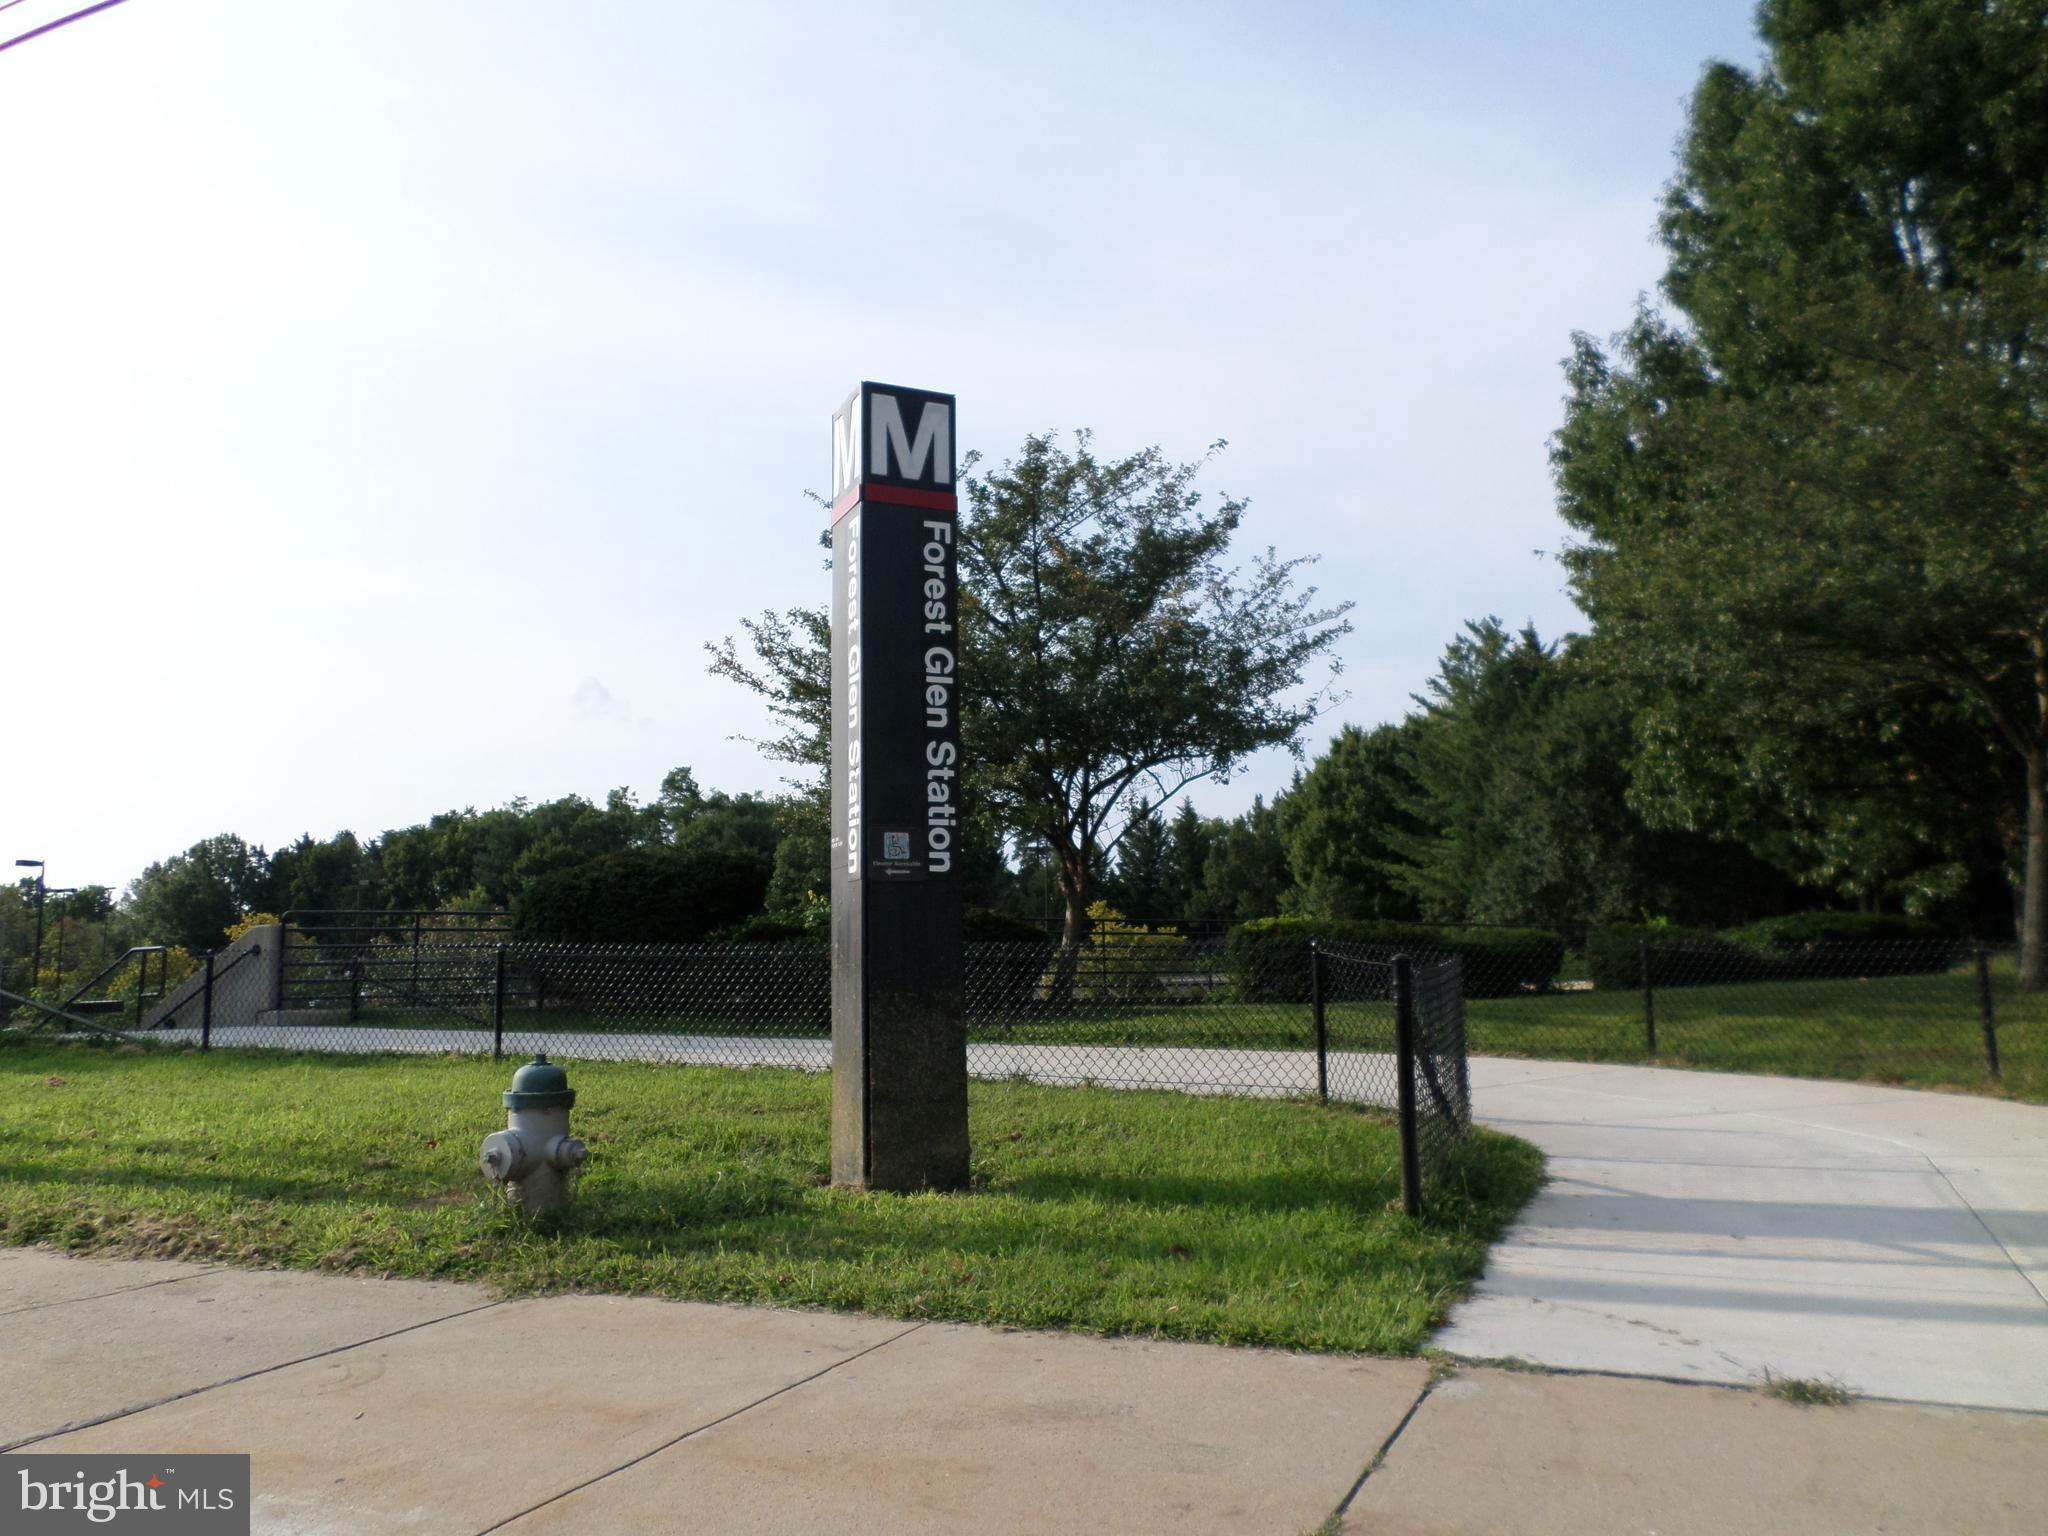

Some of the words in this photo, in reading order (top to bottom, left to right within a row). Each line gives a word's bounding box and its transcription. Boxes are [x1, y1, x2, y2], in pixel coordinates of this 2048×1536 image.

[833, 392, 860, 499] M
[870, 392, 950, 484] M
[848, 515, 860, 634] Forest
[923, 520, 952, 635] Forest
[848, 644, 860, 729] Glen
[924, 647, 955, 728] Glen
[848, 739, 860, 873] Station
[926, 740, 957, 873] Station
